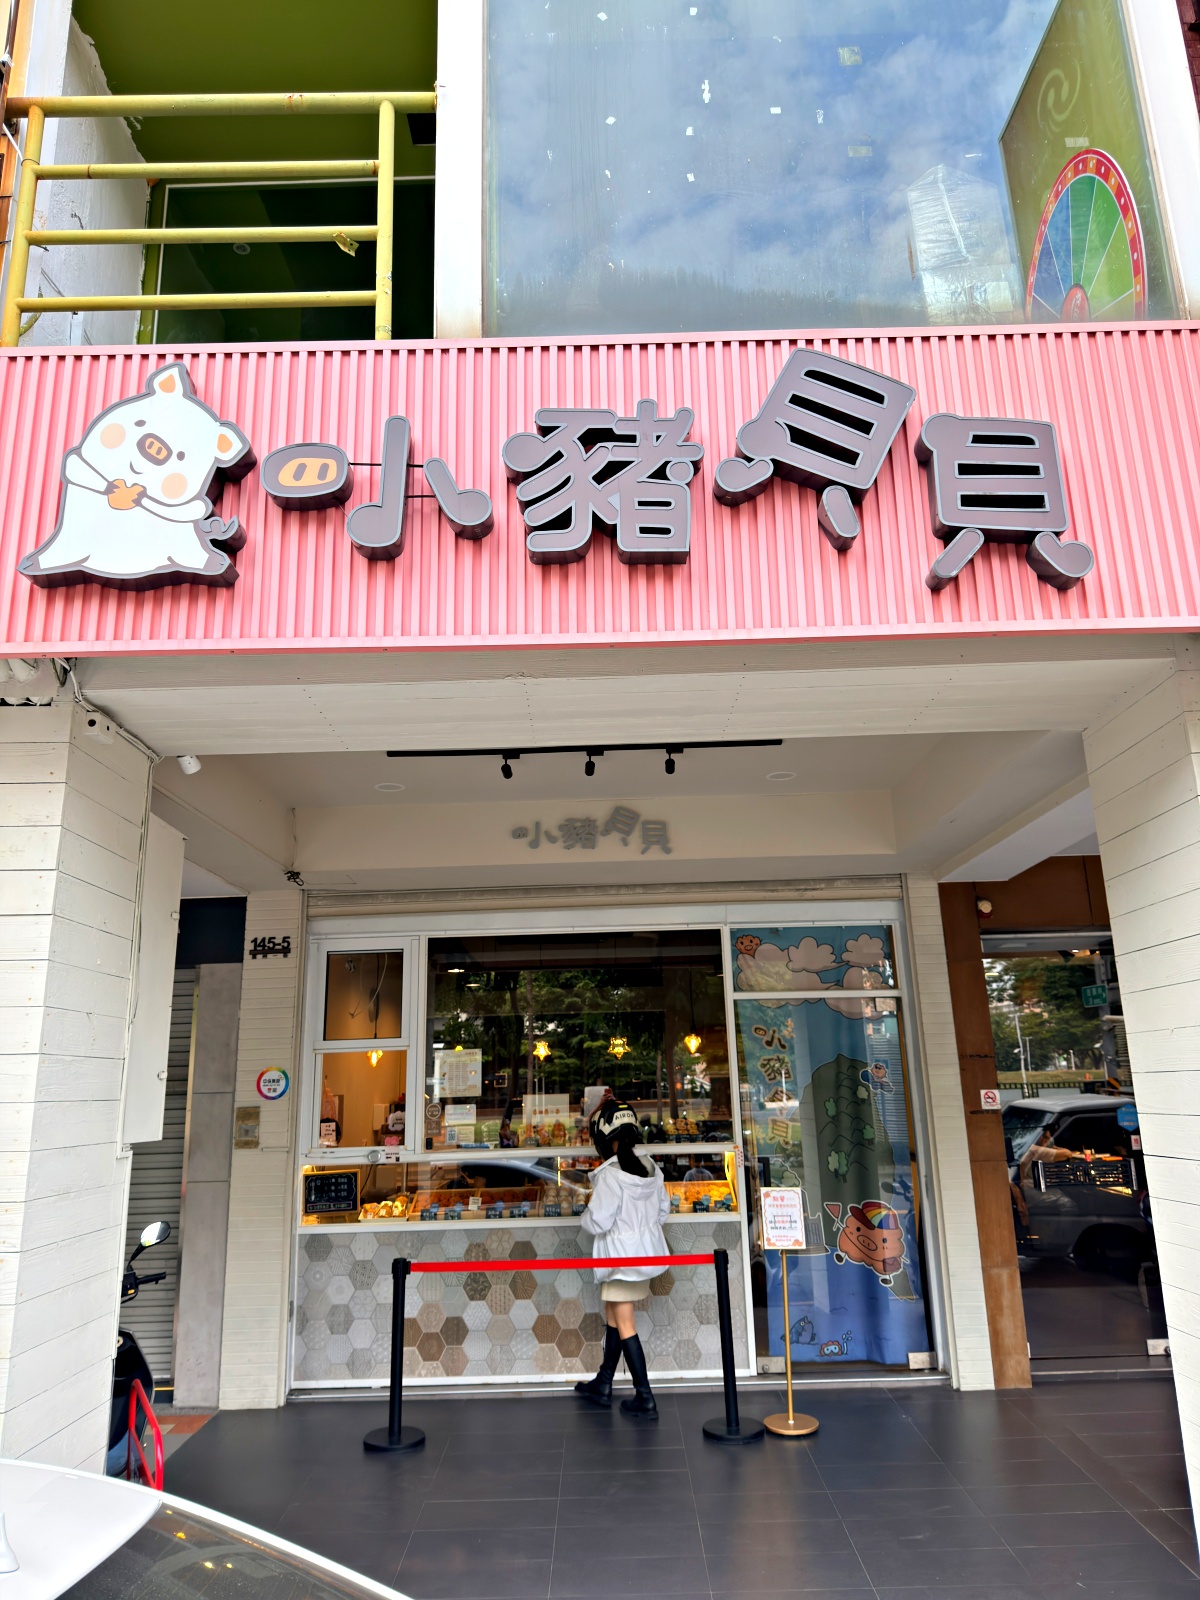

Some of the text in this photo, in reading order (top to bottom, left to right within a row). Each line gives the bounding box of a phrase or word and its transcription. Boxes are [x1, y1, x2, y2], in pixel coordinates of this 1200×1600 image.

[261, 347, 1096, 592] 小豬貝貝
[511, 805, 672, 855] 小豬貝貝
[251, 936, 291, 951] 145-5
